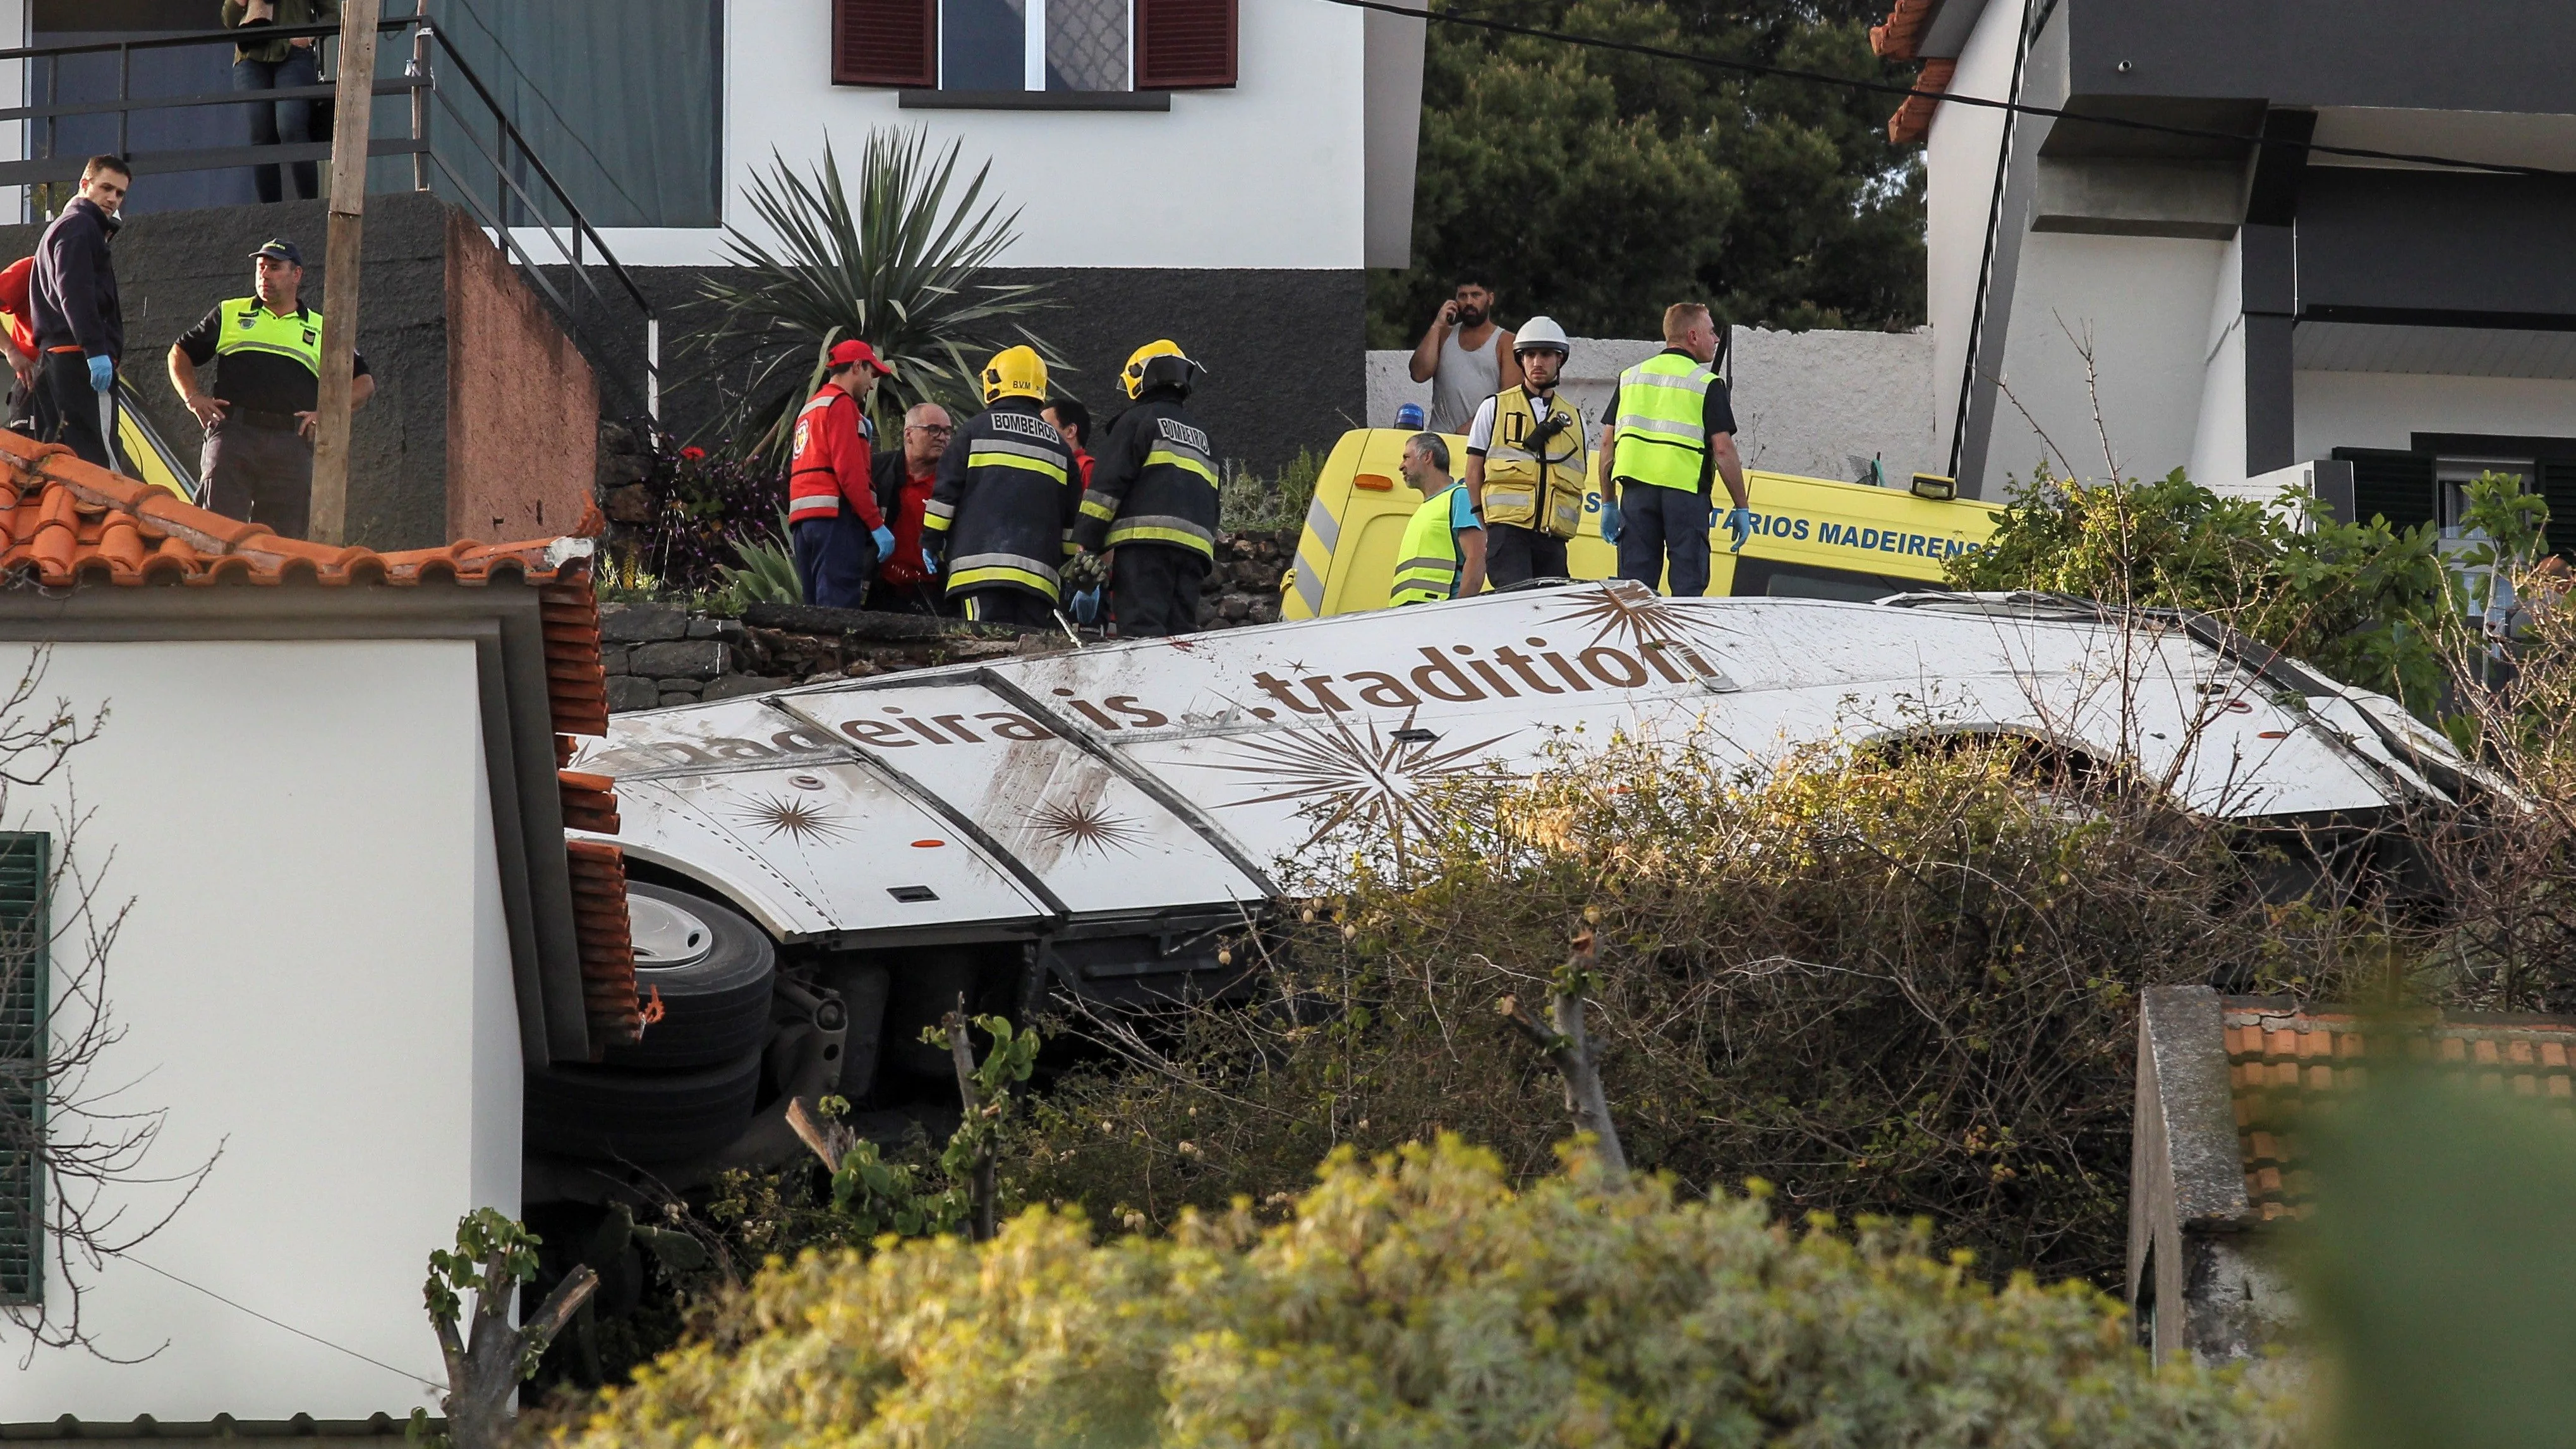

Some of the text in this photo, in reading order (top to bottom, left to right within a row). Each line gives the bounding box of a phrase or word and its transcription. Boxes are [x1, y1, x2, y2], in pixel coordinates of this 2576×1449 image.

[994, 415, 1057, 442] BOMBEIROS
[1160, 420, 1209, 452] BOMBEIROS
[1052, 688, 1168, 731] is
